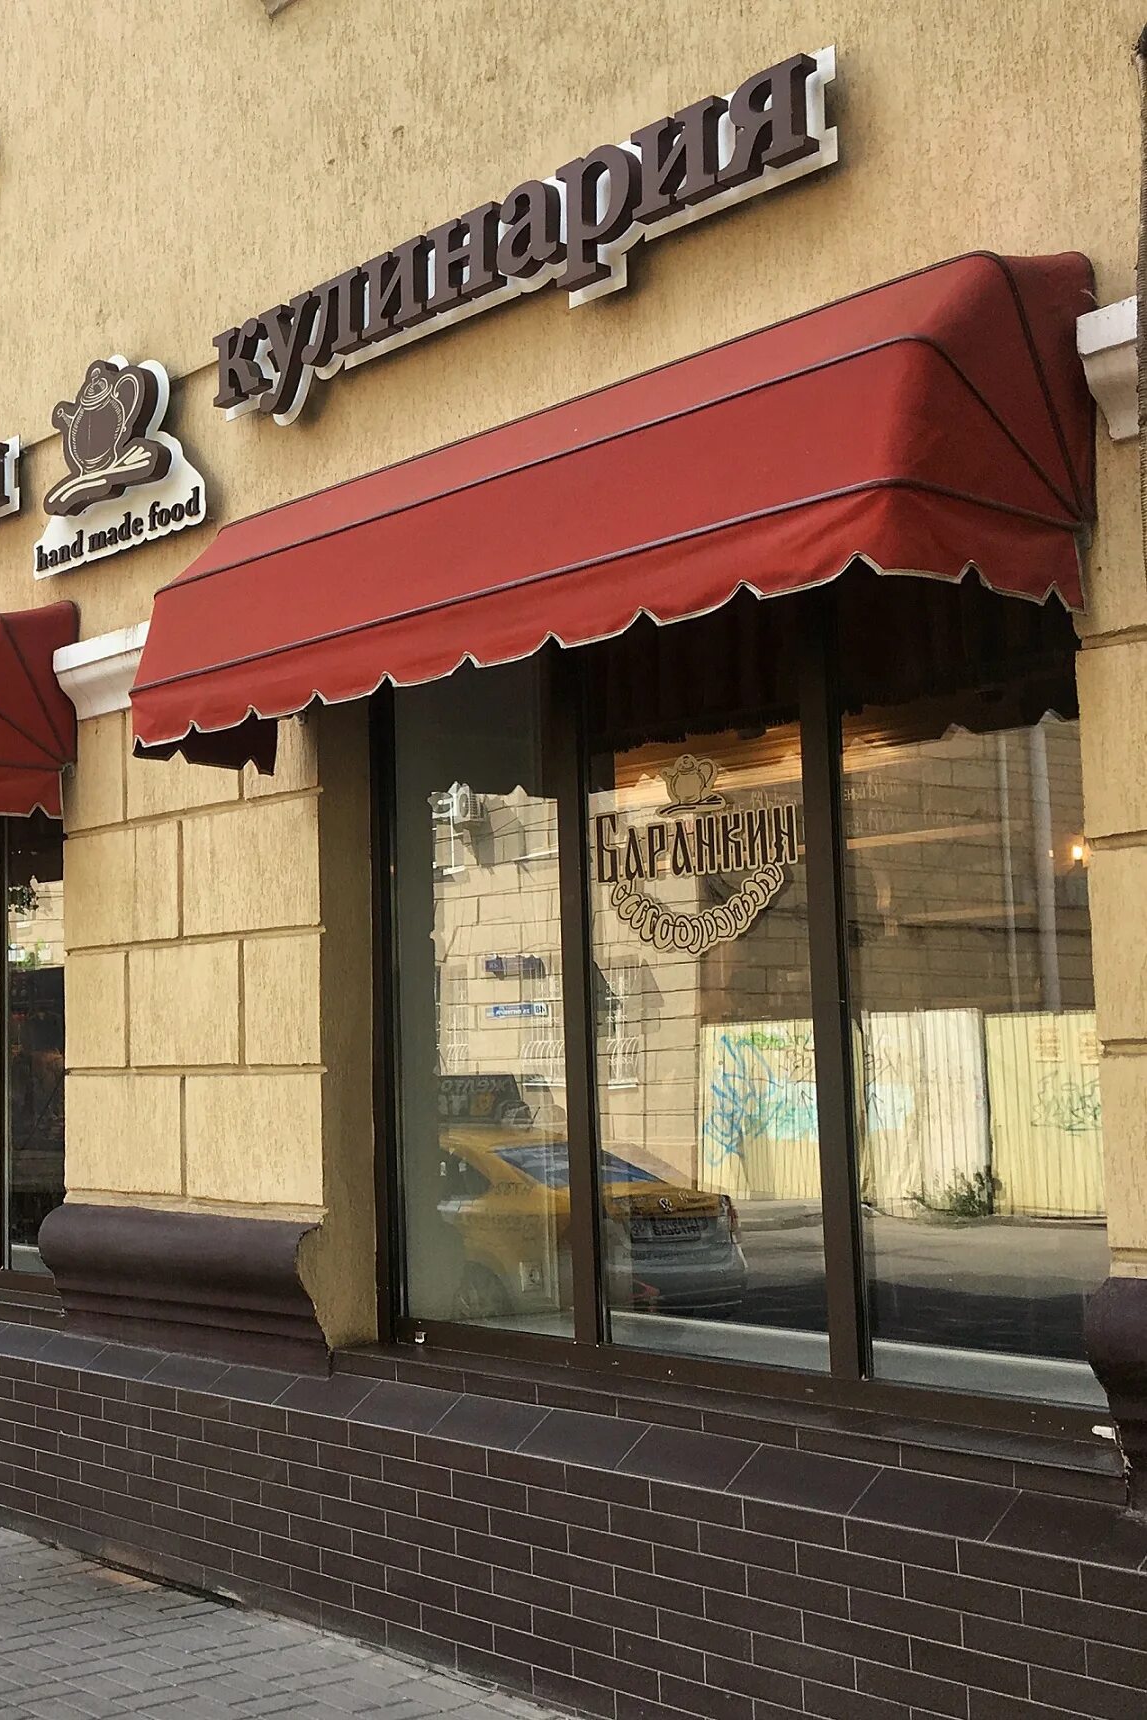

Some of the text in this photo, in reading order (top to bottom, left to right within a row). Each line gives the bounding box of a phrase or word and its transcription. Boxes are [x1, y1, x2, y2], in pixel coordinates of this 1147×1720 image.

[213, 53, 821, 415] кулинария
[36, 486, 201, 571] hand made food
